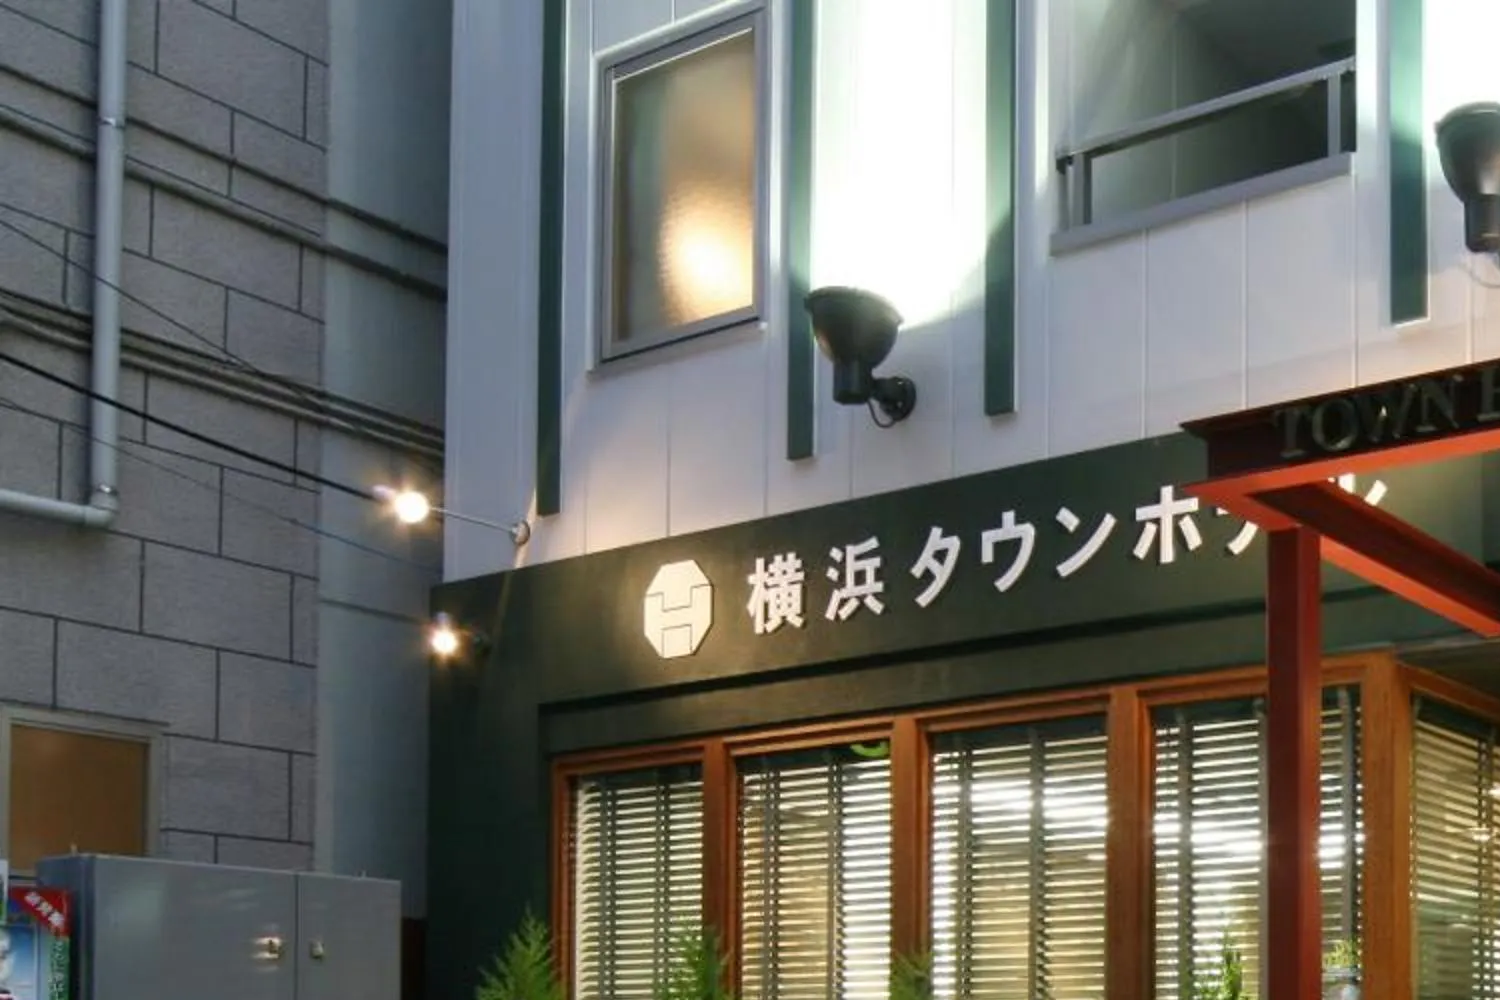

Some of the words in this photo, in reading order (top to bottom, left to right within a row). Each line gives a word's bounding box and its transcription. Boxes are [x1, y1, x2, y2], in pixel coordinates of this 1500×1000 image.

[1272, 372, 1463, 458] TOWN
[744, 473, 1388, 637] 横浜タウンホ
